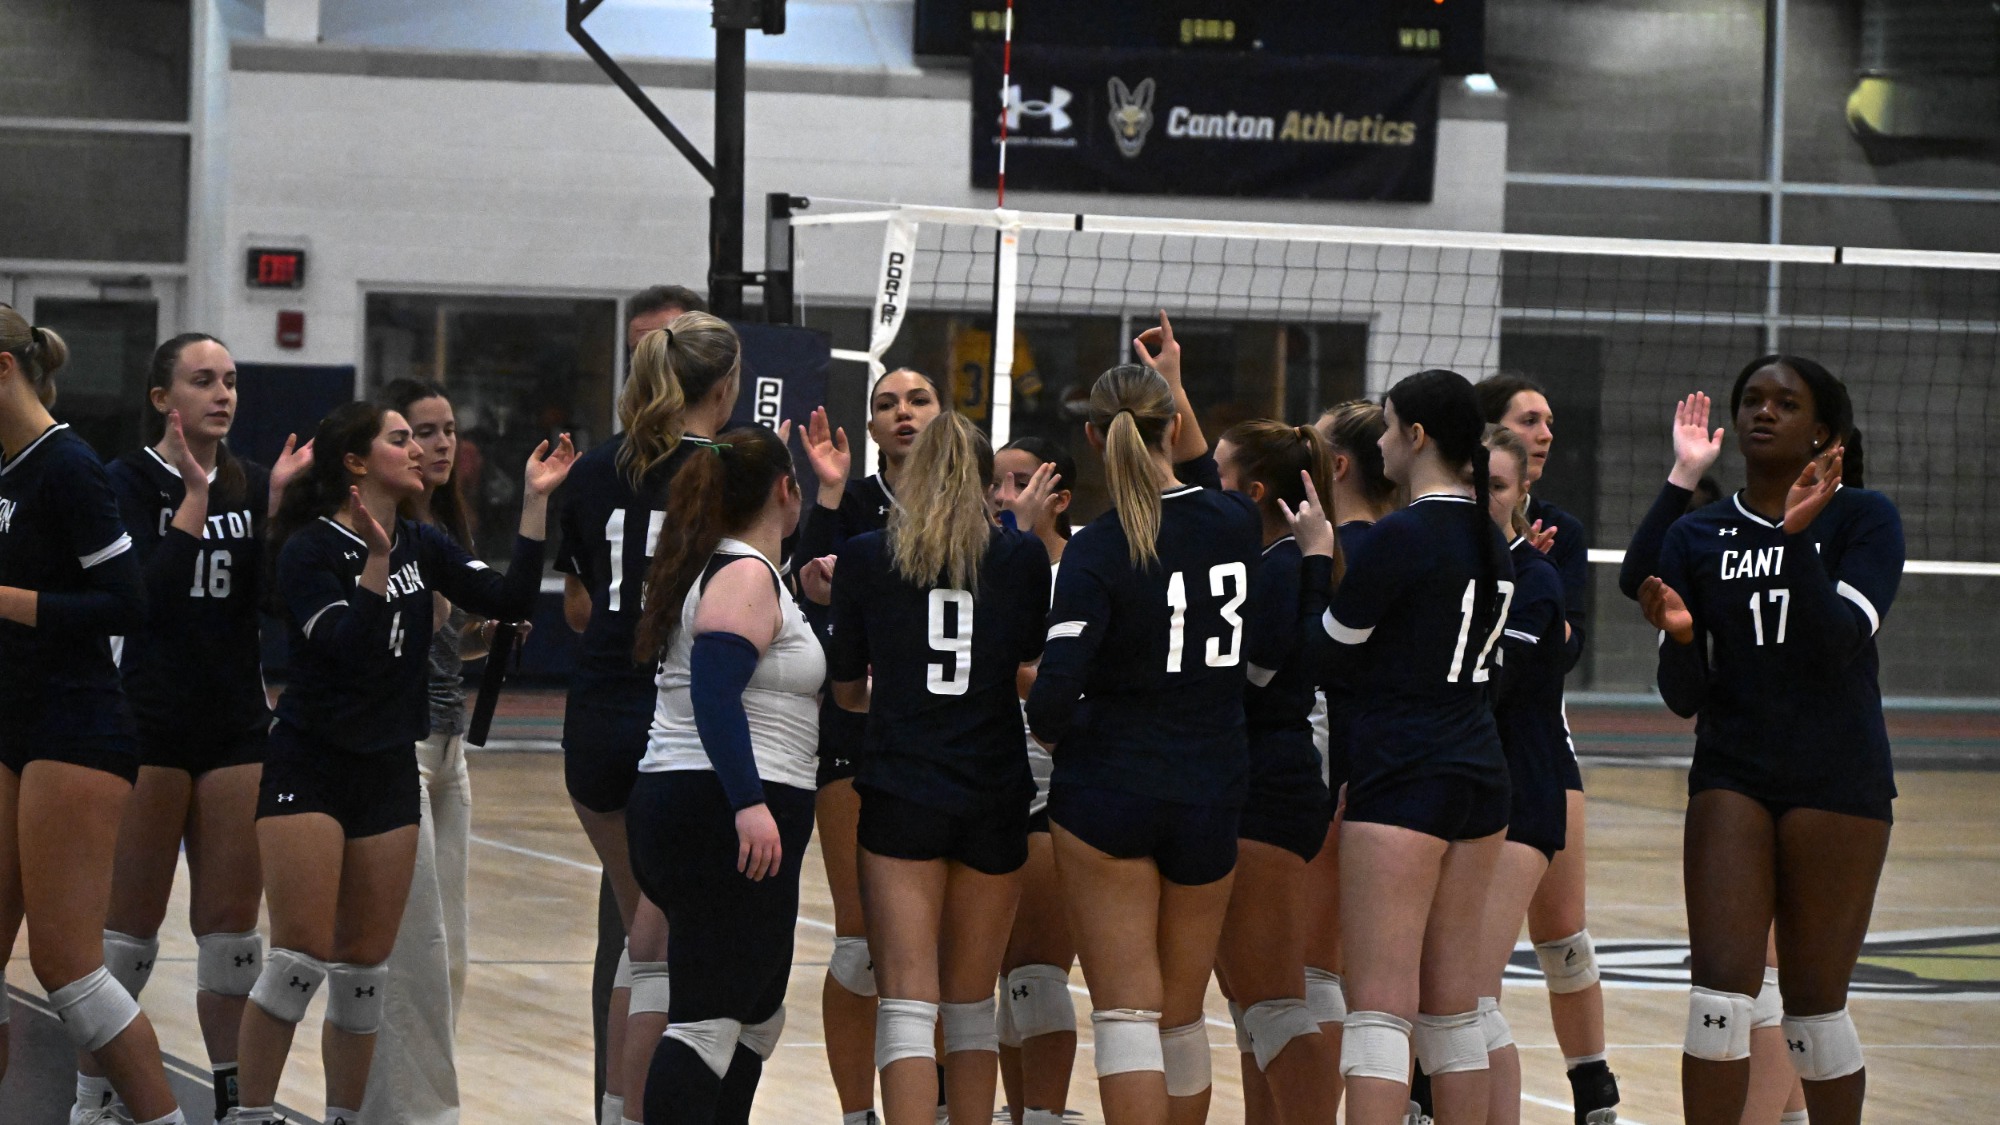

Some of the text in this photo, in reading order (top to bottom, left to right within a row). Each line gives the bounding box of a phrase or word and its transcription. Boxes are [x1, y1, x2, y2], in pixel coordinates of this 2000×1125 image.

[1166, 106, 1418, 145] Canton Athletics
[189, 549, 232, 598] 16
[1721, 541, 1821, 580] CANT
[388, 611, 405, 658] 4
[1166, 561, 1247, 673] 13
[1749, 588, 1790, 646] 17
[926, 588, 974, 696] 9
